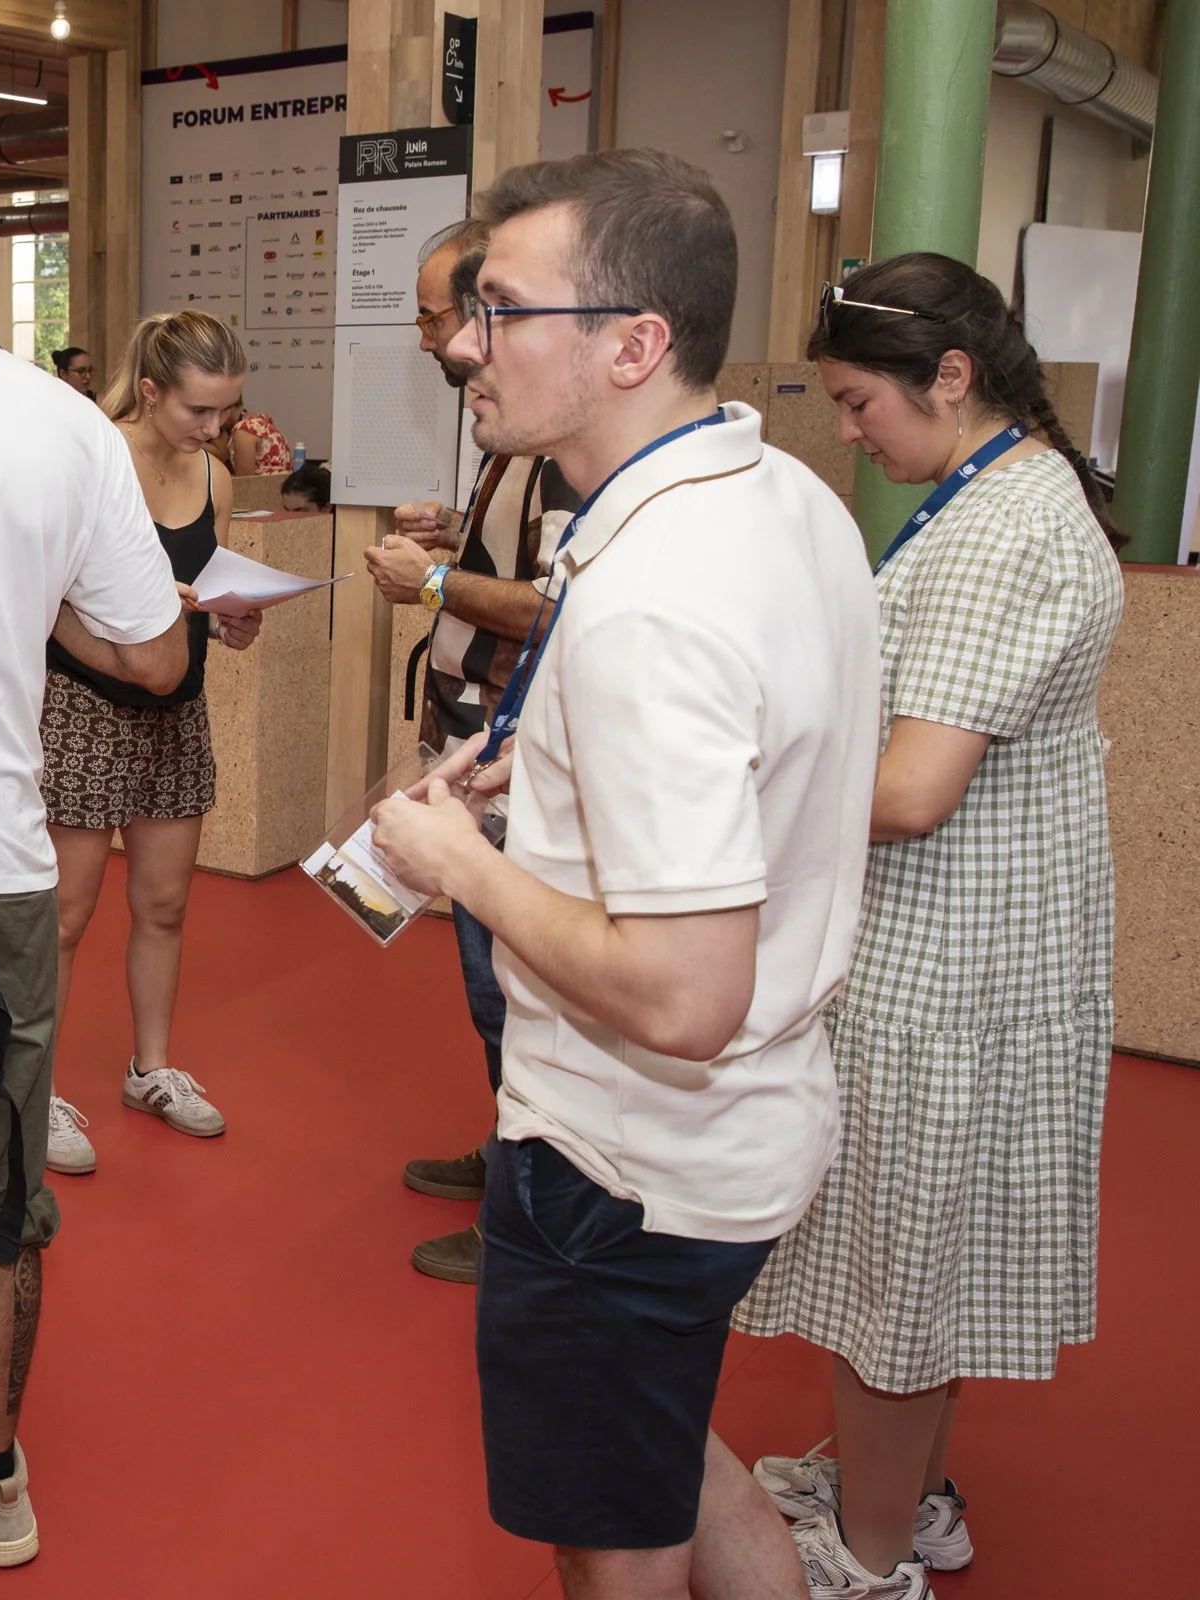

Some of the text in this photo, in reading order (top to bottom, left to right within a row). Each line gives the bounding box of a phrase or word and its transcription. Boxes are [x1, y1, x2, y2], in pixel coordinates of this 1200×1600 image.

[172, 94, 347, 129] FORUM ENTREPR
[404, 161, 422, 169] Palais
[353, 206, 365, 214] Rez
[376, 204, 407, 213] chaussée
[257, 209, 321, 221] PARTENAIRES
[352, 268, 370, 277] Étage
